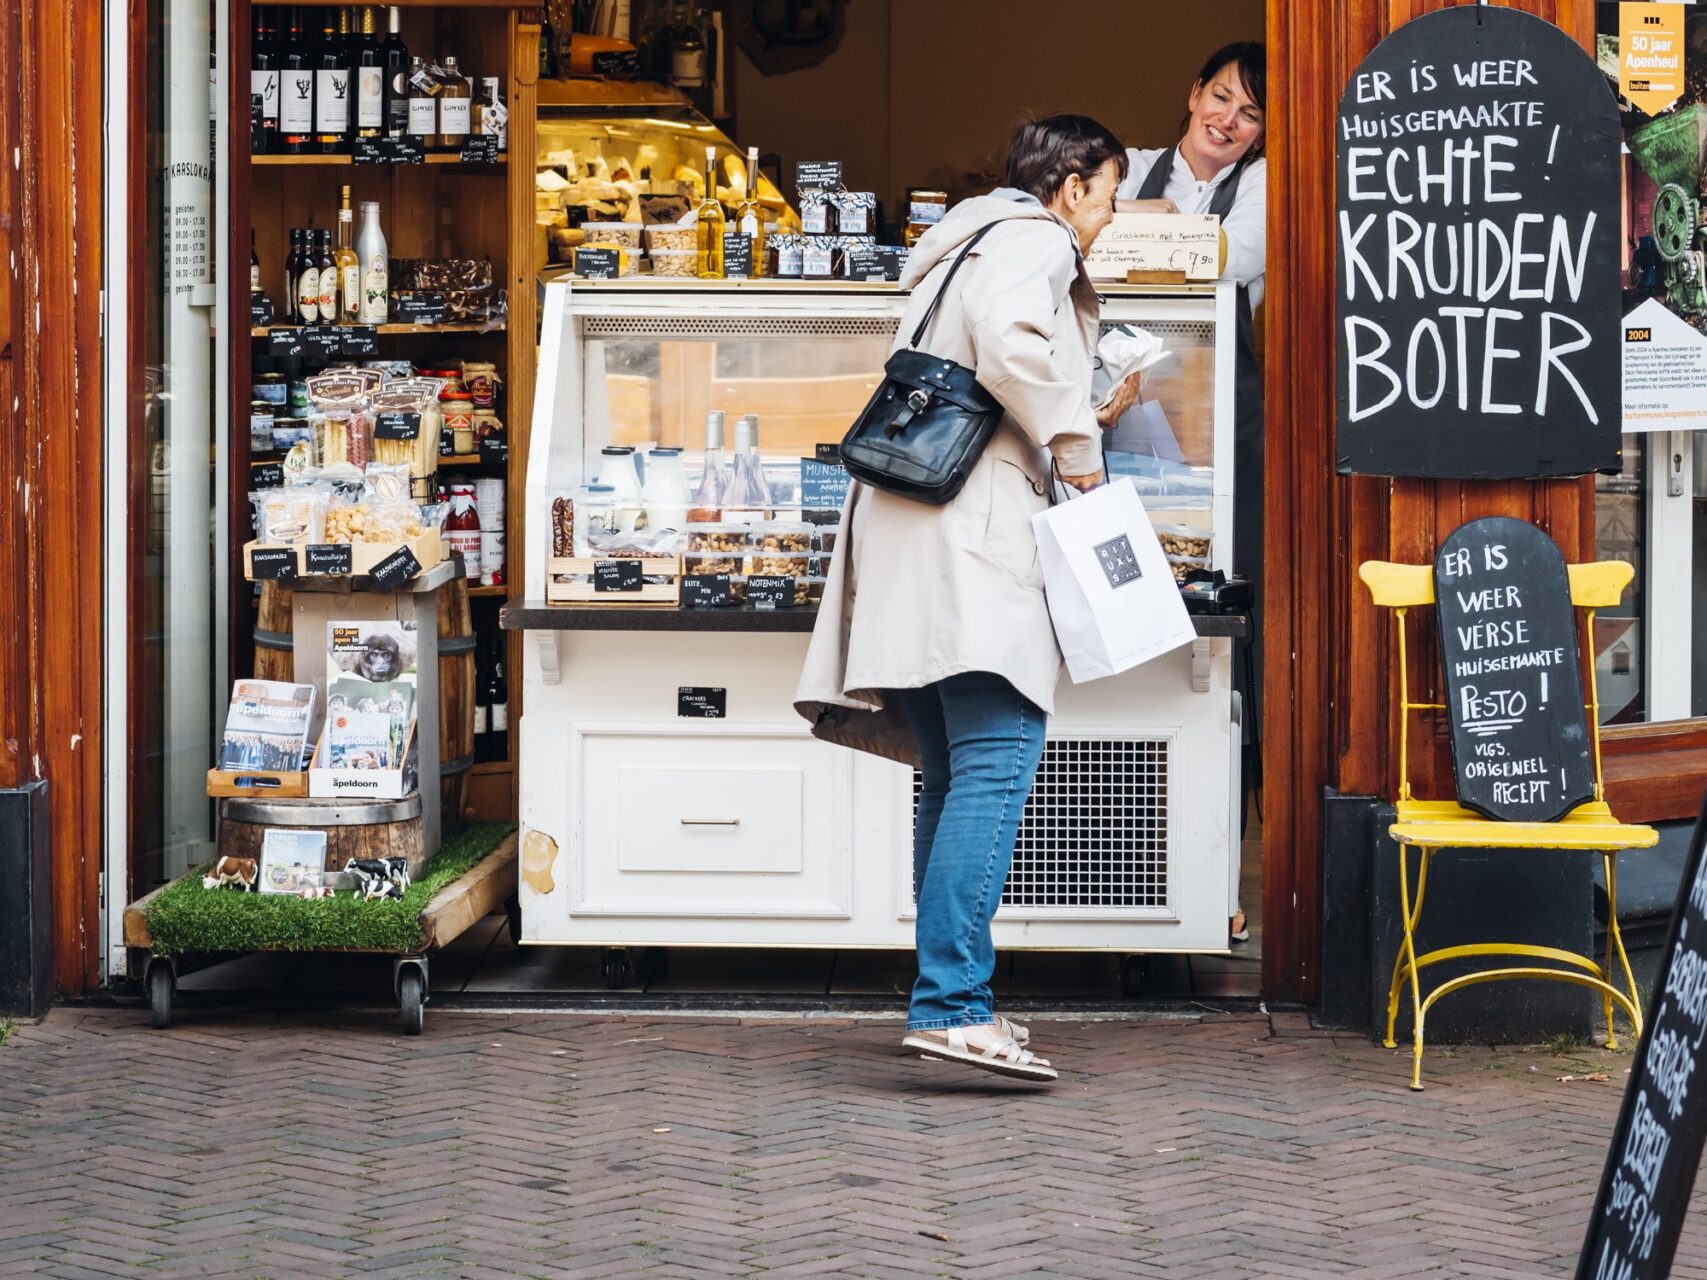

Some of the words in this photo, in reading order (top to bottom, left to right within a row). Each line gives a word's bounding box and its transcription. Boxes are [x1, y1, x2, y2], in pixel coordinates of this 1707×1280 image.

[1632, 36, 1648, 51] 50
[1650, 36, 1672, 54] jaar
[1626, 53, 1678, 72] Apenheul
[1356, 71, 1395, 104] ER
[1453, 59, 1538, 87] WEER
[172, 162, 213, 184] KAASLOKAA
[1347, 135, 1523, 206] ECHTE
[1339, 210, 1598, 304] KRUIDEN
[1628, 330, 1649, 340] 2004
[1344, 308, 1599, 426] BOTER
[1443, 548, 1472, 577] ER
[1457, 585, 1522, 613] WEER
[334, 644, 368, 652] Apeldoorn
[1493, 780, 1550, 805] RECEPT
